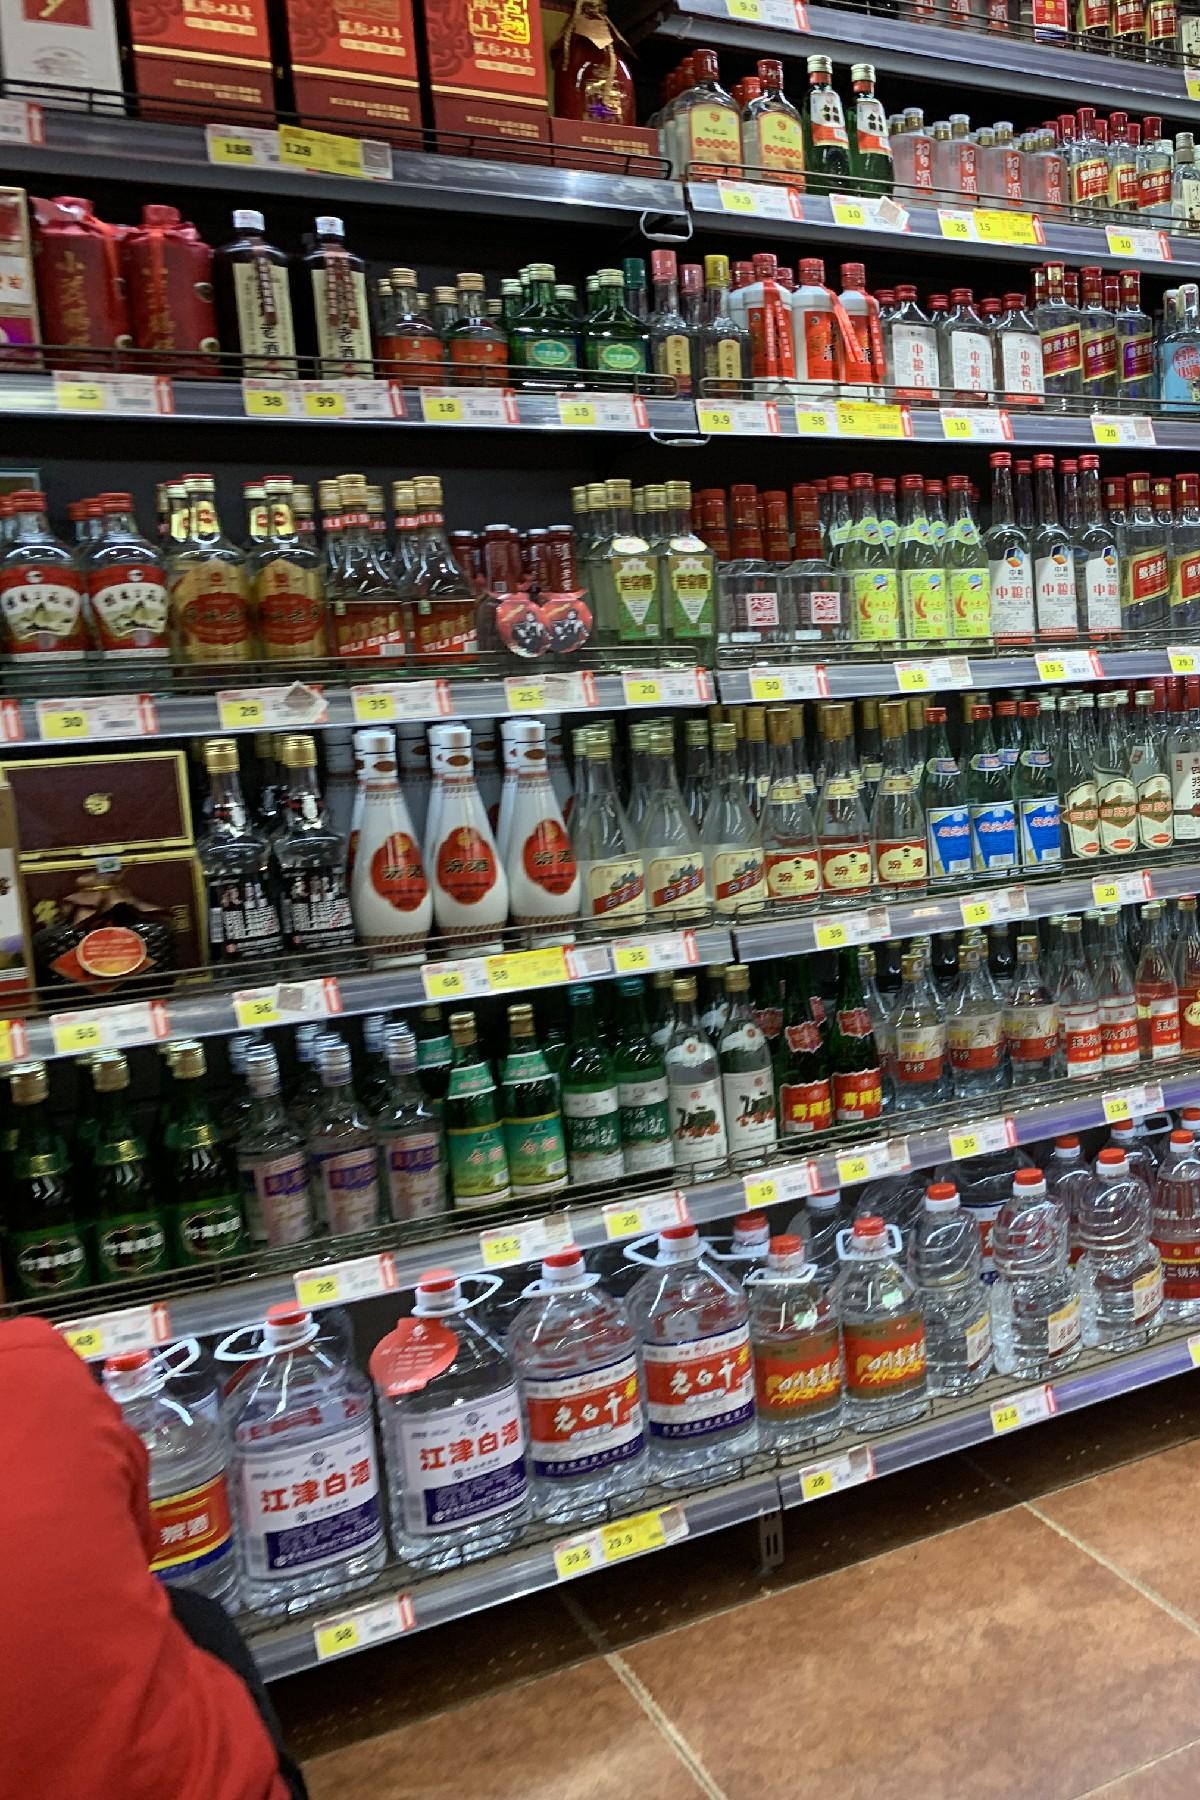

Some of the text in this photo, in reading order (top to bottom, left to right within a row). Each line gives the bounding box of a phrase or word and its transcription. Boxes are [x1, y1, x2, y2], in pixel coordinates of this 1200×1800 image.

[669, 1358, 738, 1396] 老白干
[553, 1392, 623, 1433] 老白干
[418, 1416, 518, 1473] 江津白酒
[261, 1457, 371, 1514] 江津白酒
